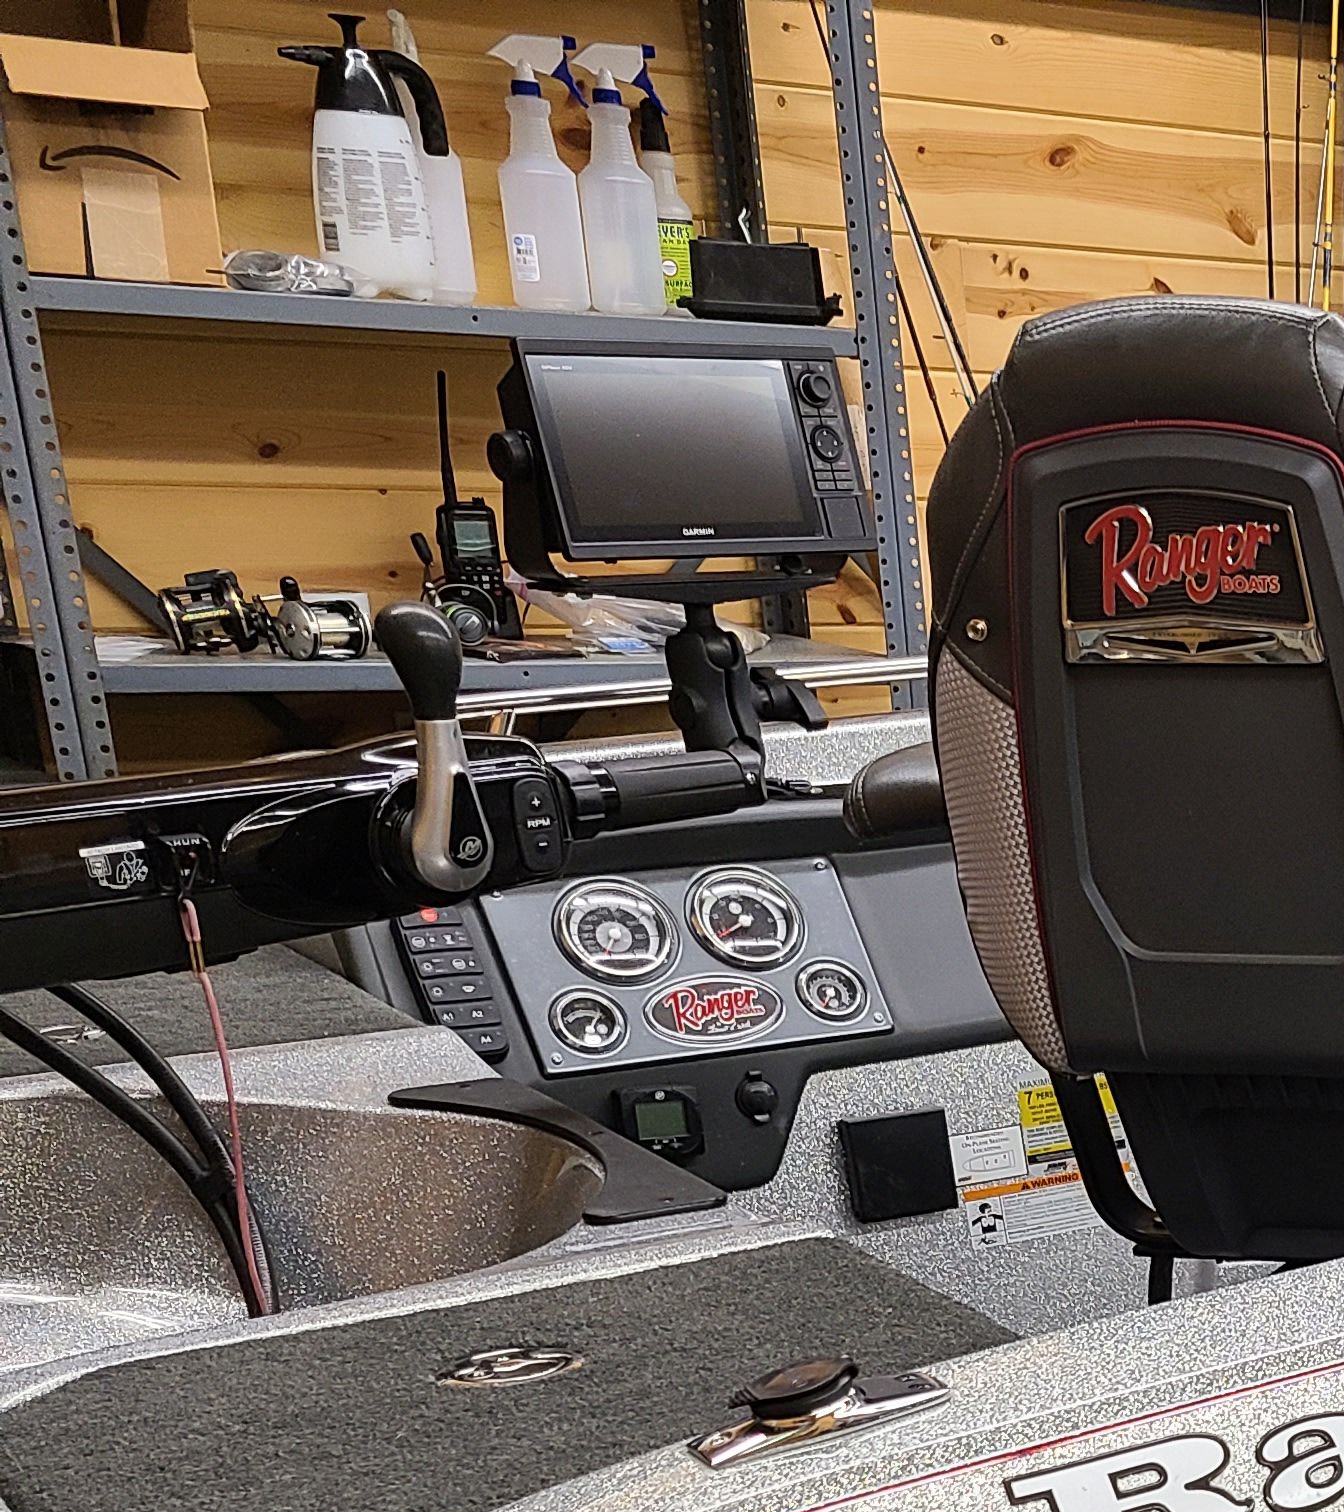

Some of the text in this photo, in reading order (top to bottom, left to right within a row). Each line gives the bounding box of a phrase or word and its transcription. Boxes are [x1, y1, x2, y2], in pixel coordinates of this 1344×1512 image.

[658, 224, 690, 238] YER'S
[666, 279, 692, 288] SURFAC
[1085, 505, 1279, 616] Ranger
[1220, 575, 1280, 593] BOATS
[527, 817, 551, 829] RPM
[472, 1010, 484, 1018] A2
[664, 986, 759, 1034] Ranger
[1024, 1091, 1032, 1105] 7
[1036, 1091, 1054, 1100] PERS
[1032, 1172, 1079, 1189] WARNING
